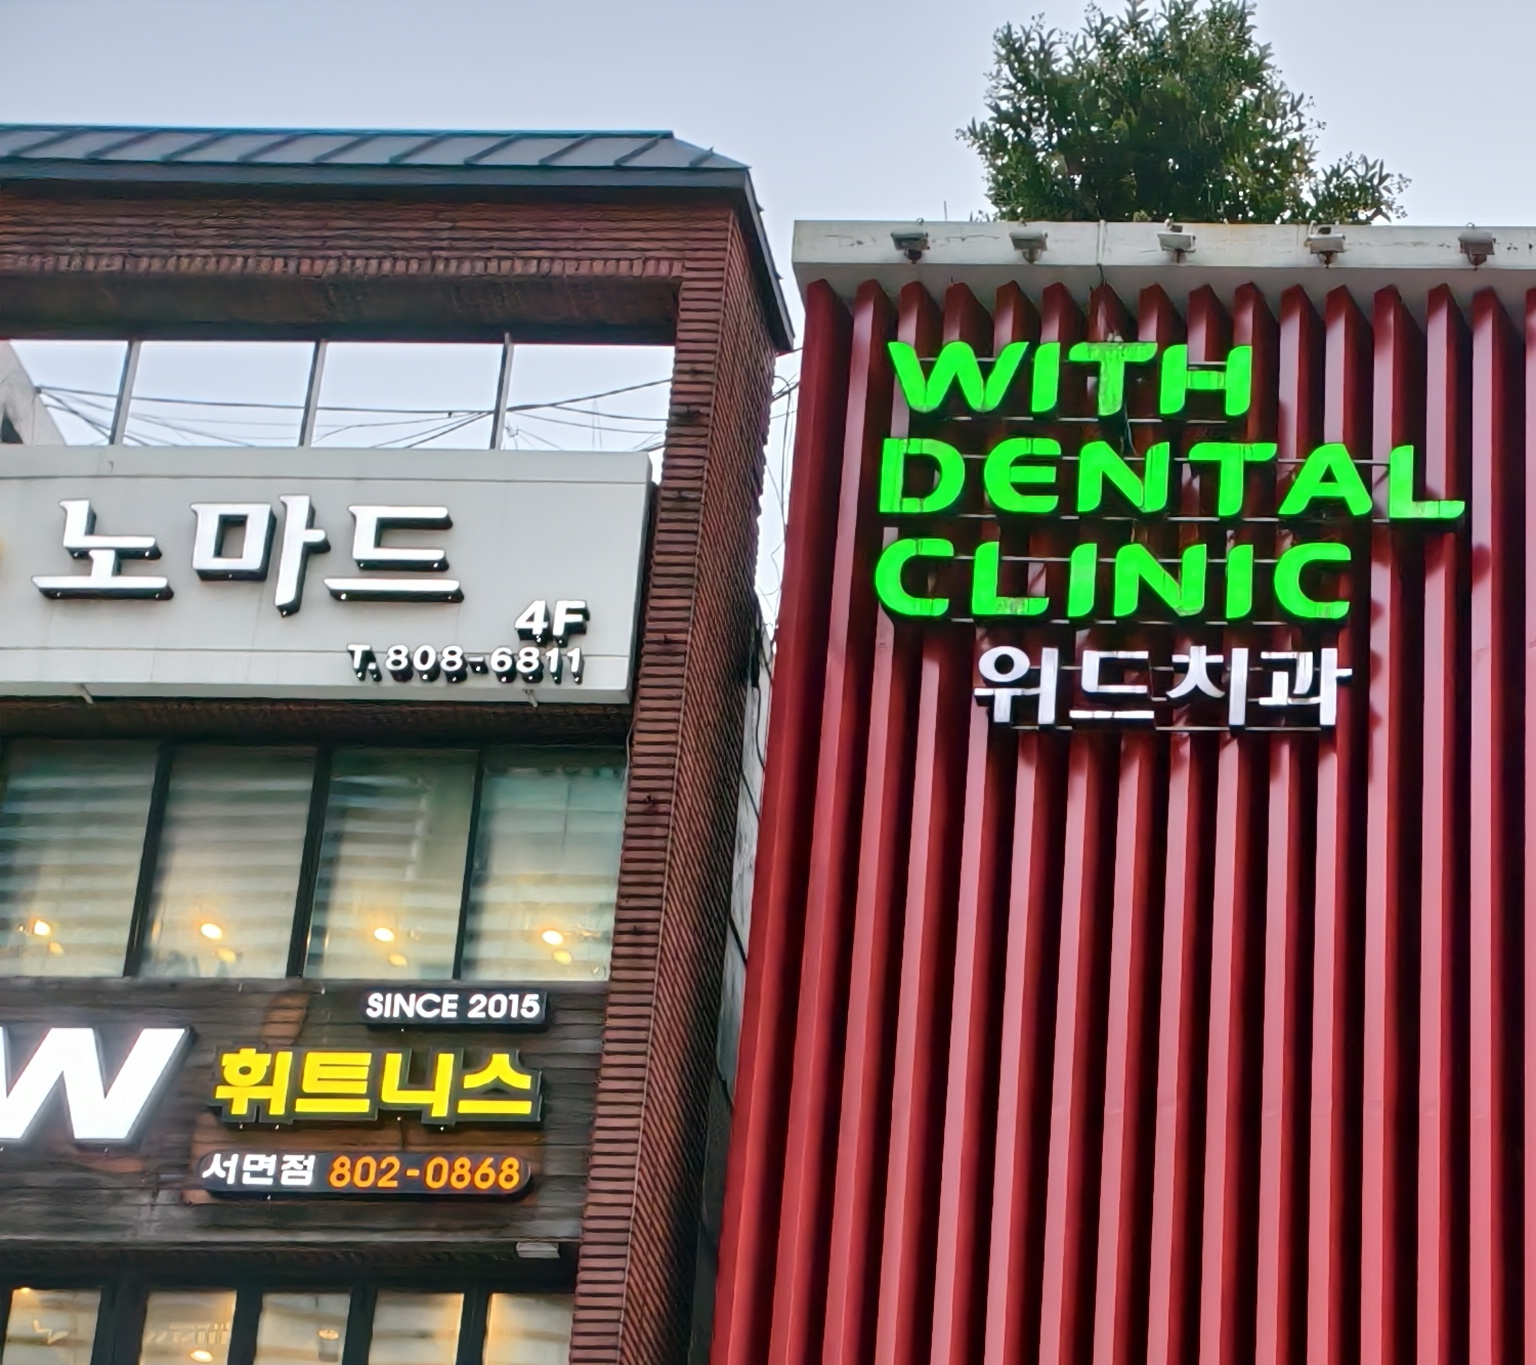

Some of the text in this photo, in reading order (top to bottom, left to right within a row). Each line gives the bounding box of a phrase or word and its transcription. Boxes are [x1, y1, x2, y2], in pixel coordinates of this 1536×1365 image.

[887, 340, 1253, 417] WITH
[878, 437, 1466, 520] DENTAL
[31, 494, 463, 614] 노마드
[874, 537, 1353, 619] CLINIC
[514, 600, 590, 643] 4F
[974, 644, 1353, 727] 위드치과
[365, 992, 542, 1020] SINCE 2015
[215, 1047, 540, 1118] 휘트니스
[201, 1150, 522, 1192] 서면점 802-0868
